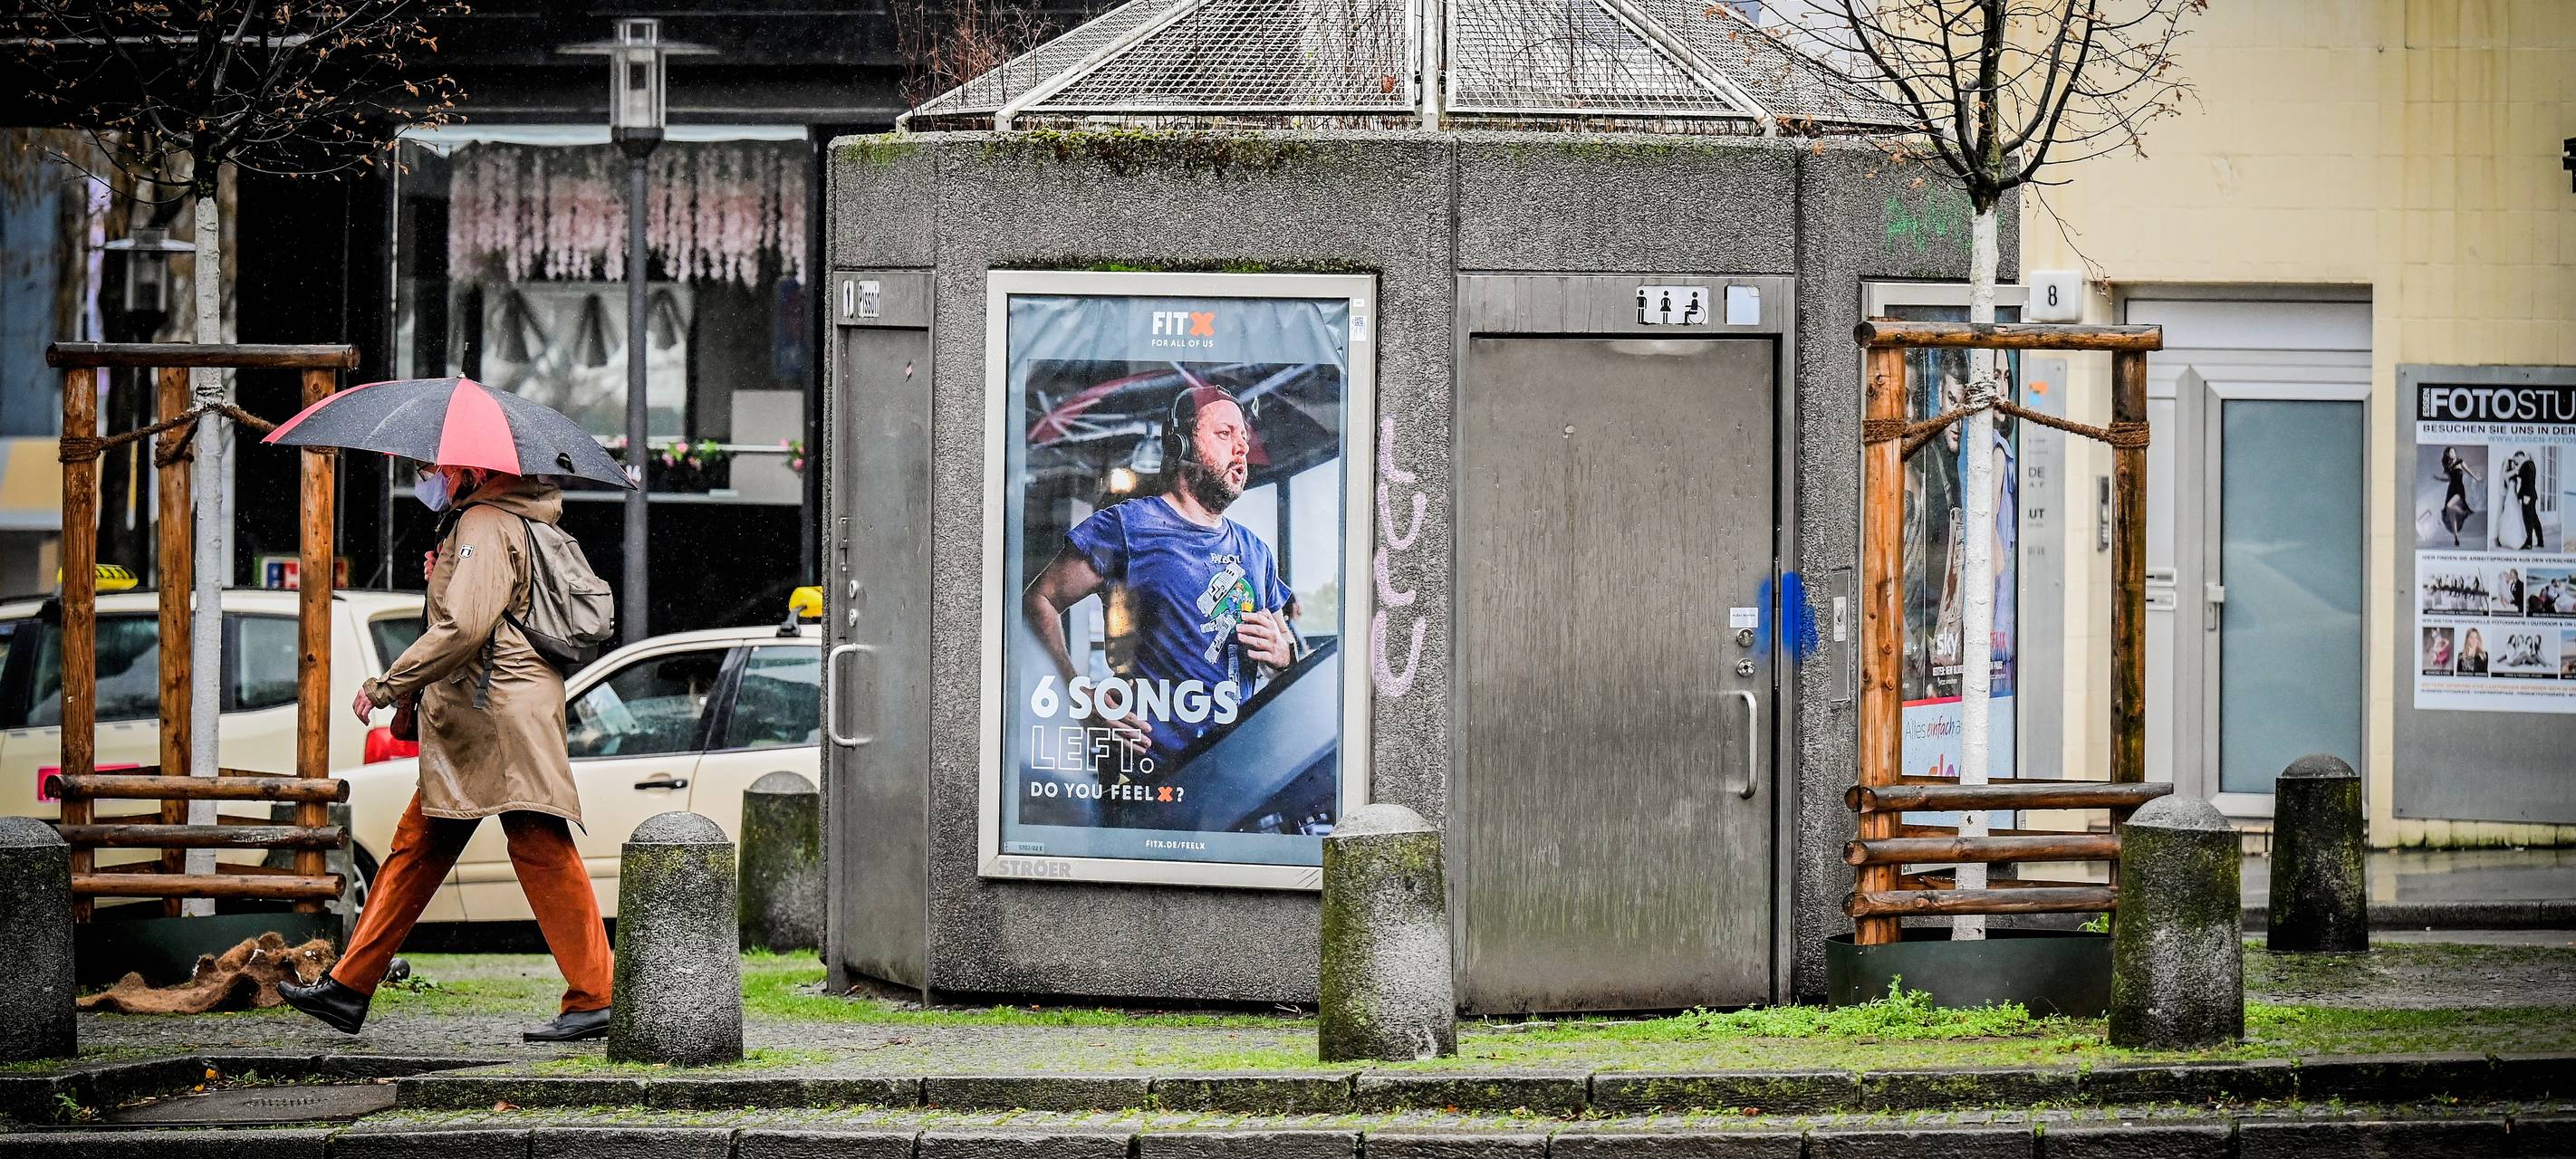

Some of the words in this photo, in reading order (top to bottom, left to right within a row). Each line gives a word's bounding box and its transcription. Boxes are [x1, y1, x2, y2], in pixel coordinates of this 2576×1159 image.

[2048, 284, 2058, 307] 8
[1152, 311, 1216, 337] FITX
[1151, 339, 1168, 347] FOR
[1170, 340, 1186, 348] ALL
[1188, 340, 1200, 348] OF
[1203, 340, 1215, 348] US
[2430, 387, 2576, 420] FOTOSTU
[2423, 424, 2485, 434] BESUCHEN
[2489, 425, 2506, 435] SIE
[2511, 426, 2534, 435] UNS
[2538, 426, 2549, 435] IN
[2552, 426, 2576, 436] DER
[1937, 627, 1958, 661] sky
[1030, 675, 1059, 718] 6
[1069, 675, 1239, 724] SONGS
[1905, 719, 1926, 740] Alles
[1927, 715, 1954, 739] einfach
[1031, 724, 1154, 774] LEFT.
[1031, 781, 1058, 798] DO
[1063, 782, 1102, 800] YOU
[1110, 784, 1154, 801] FEEL
[1145, 839, 1206, 849] FITX.DE/FEELX
[998, 859, 1072, 877] STRÖER
